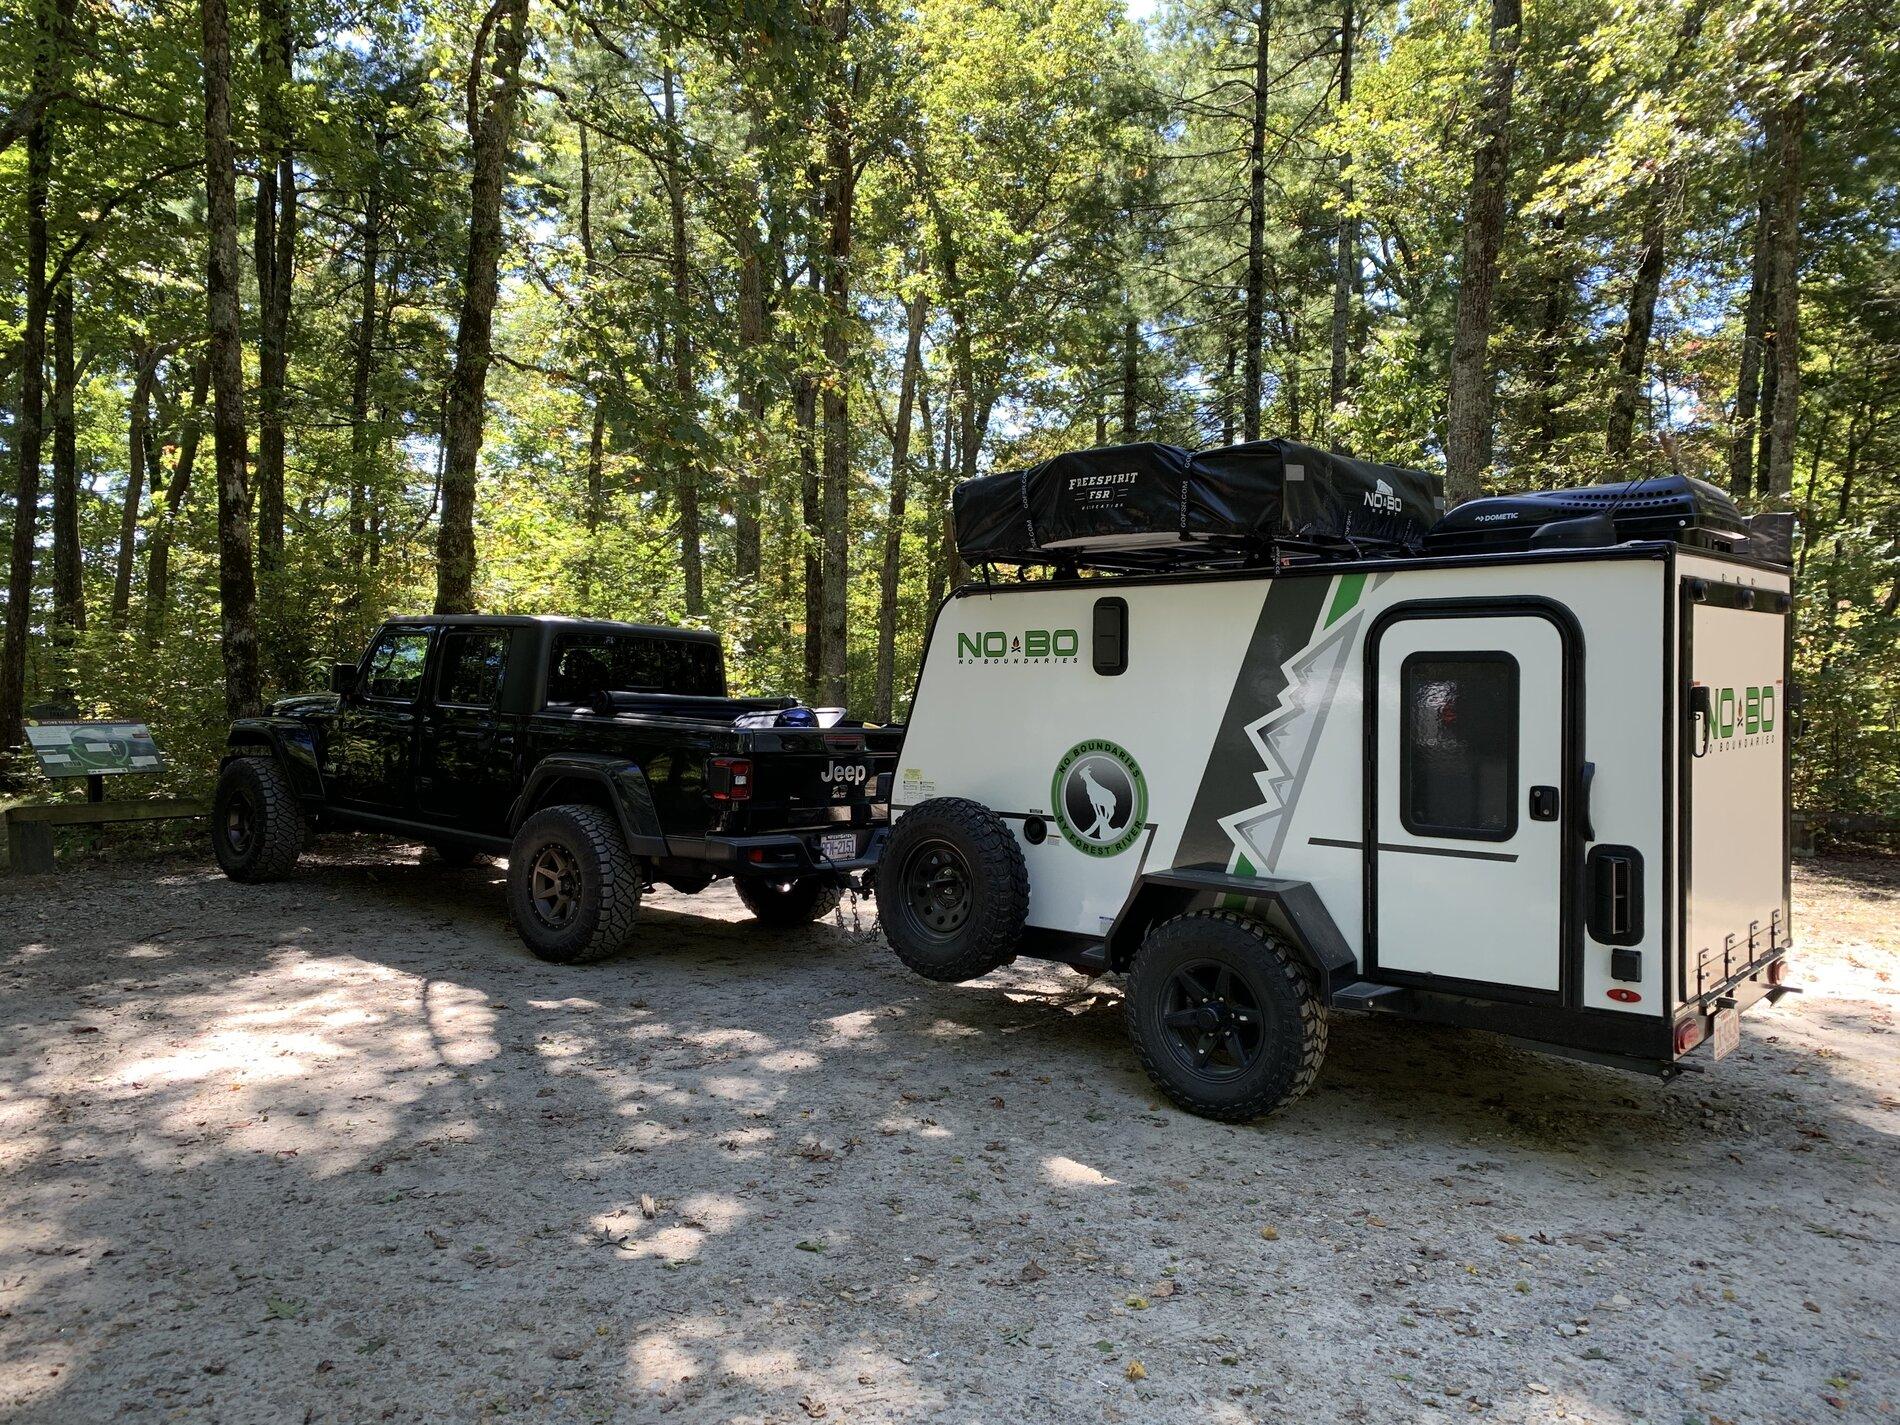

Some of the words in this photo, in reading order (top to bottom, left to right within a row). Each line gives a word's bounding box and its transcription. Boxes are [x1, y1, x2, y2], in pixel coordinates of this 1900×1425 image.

[1068, 472, 1138, 490] FREESPIRIT
[1089, 490, 1110, 499] FSR
[1180, 480, 1188, 528] GOFSR.COM
[1484, 512, 1519, 521] DOMETIC
[984, 657, 1078, 665] BOUNDARIES
[1720, 735, 1775, 752] BOUNDARIES
[1059, 757, 1071, 774] NO
[1073, 742, 1140, 778] BOUNDARIES
[820, 760, 866, 785] Jeep
[1057, 815, 1069, 830] BY
[1069, 834, 1111, 855] FOREST
[1115, 820, 1142, 851] RIVER
